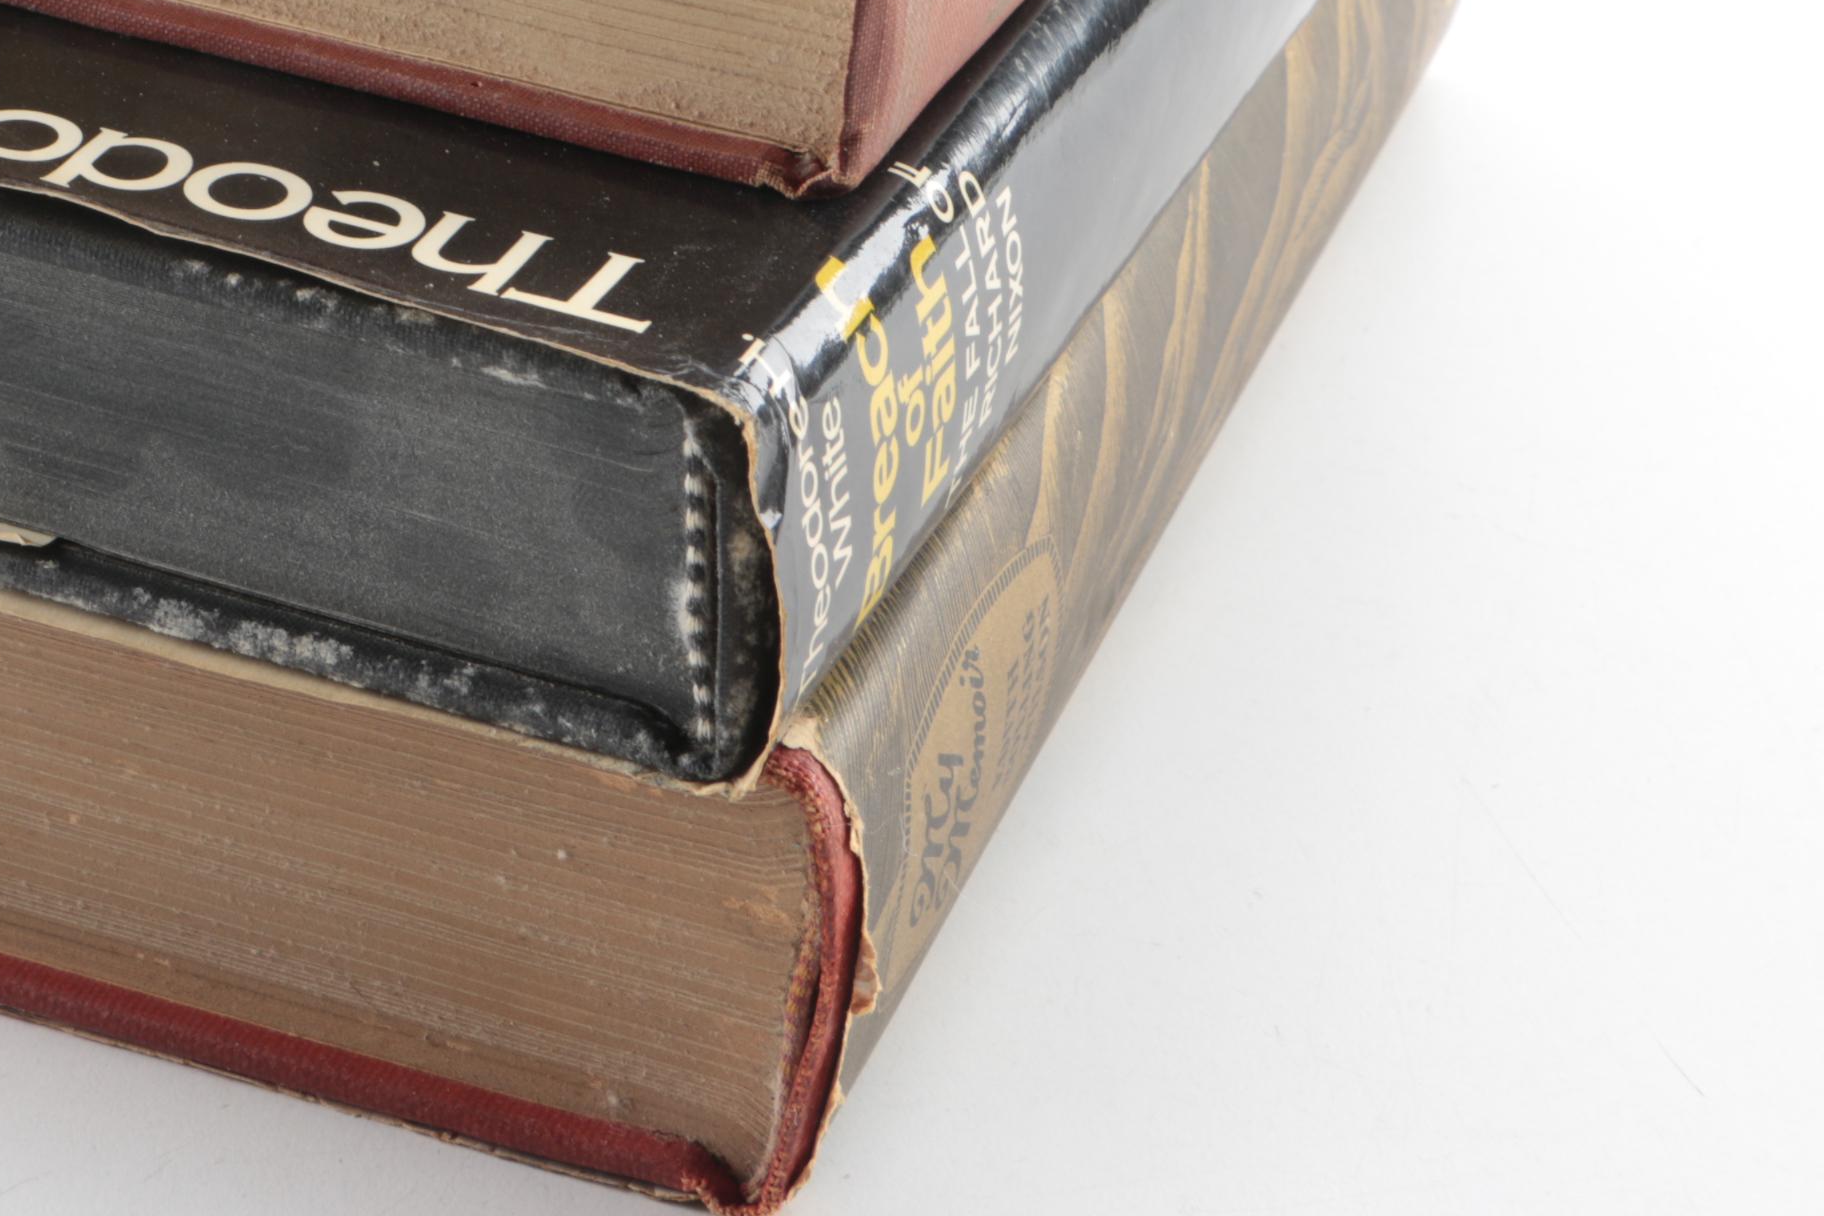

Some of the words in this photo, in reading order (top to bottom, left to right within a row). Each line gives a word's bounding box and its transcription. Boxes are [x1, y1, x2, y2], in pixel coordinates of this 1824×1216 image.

[887, 160, 955, 224] OF
[996, 186, 1024, 366] NIXON
[909, 234, 957, 508] Faith
[954, 224, 981, 381] FALL
[958, 170, 1003, 429] RICHARD
[814, 254, 900, 634] Breach
[822, 396, 853, 590] White
[897, 366, 925, 448] of
[943, 386, 979, 510] THE
[788, 395, 832, 710] Theodore
